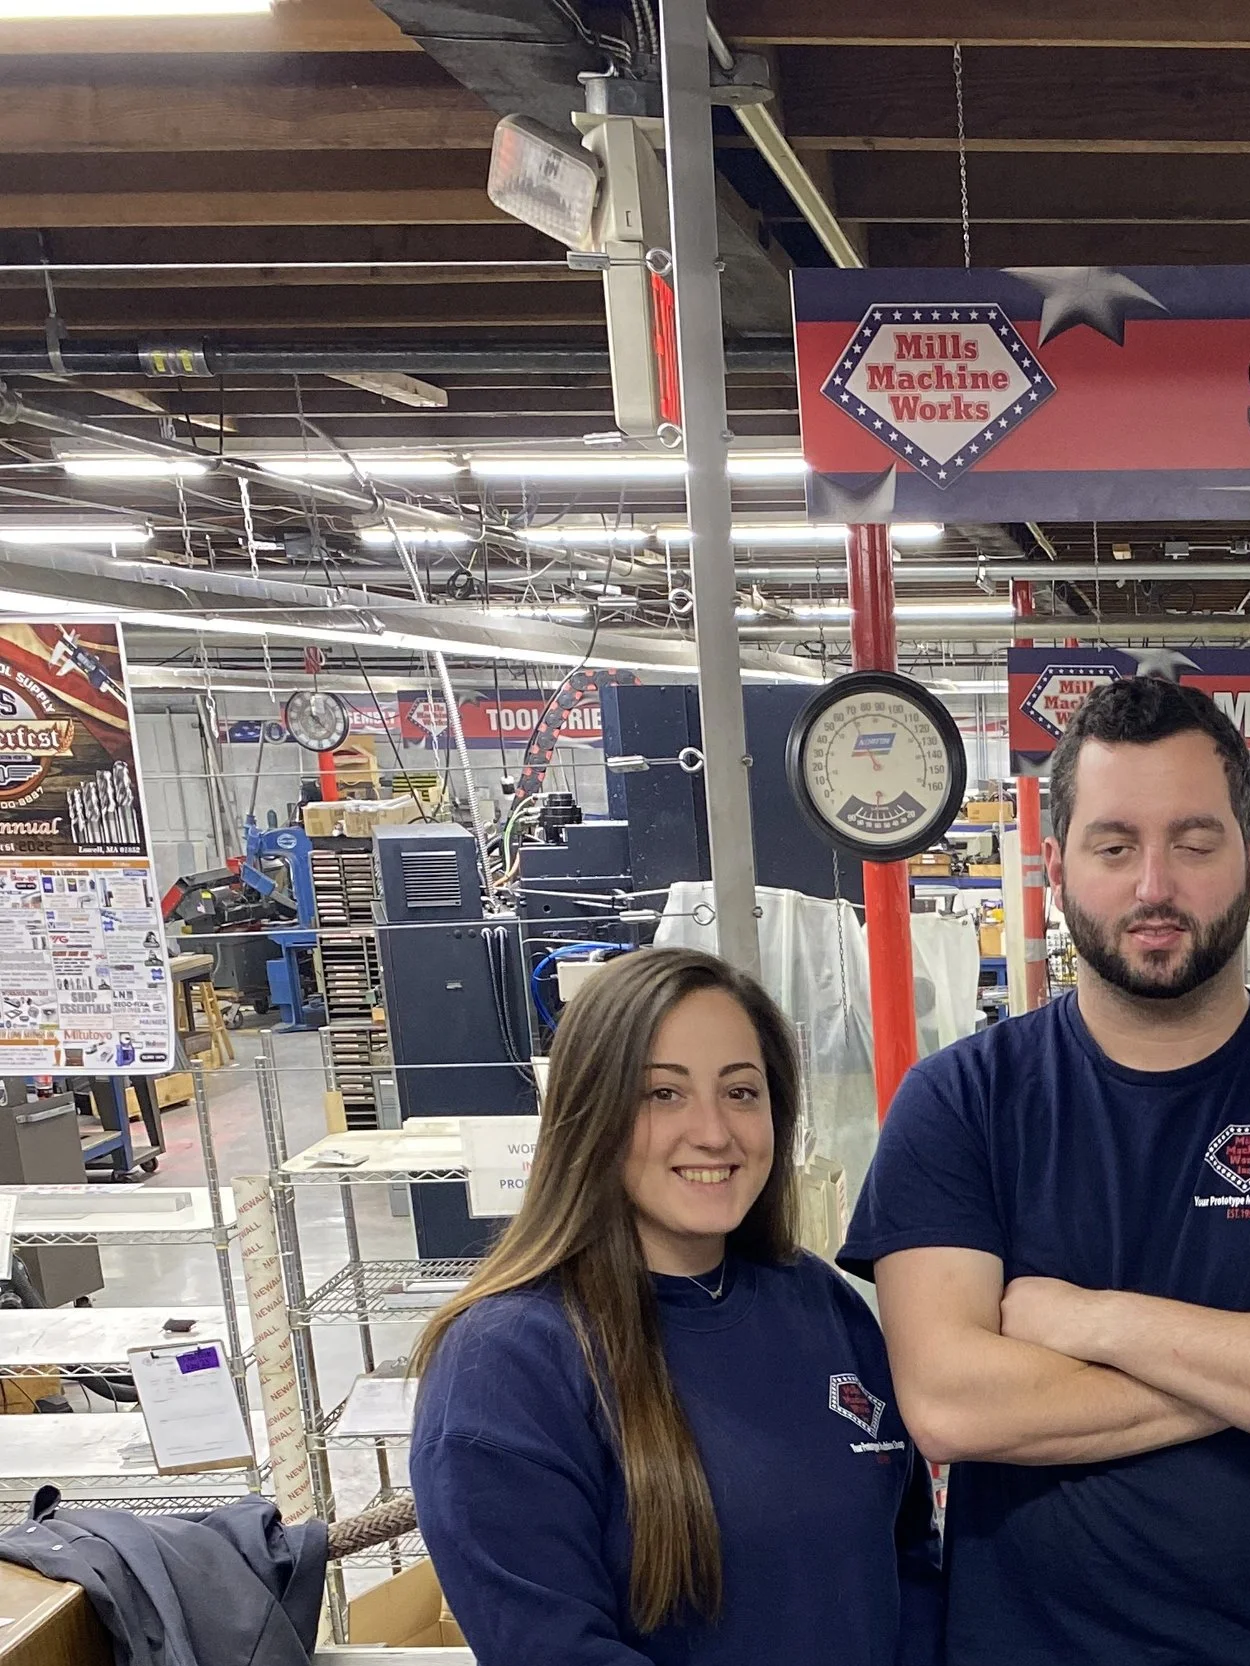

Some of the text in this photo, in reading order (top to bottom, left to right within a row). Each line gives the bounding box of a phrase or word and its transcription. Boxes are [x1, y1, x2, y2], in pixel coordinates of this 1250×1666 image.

[893, 333, 979, 360] Mills
[866, 364, 1009, 391] Machine
[889, 395, 990, 422] Works
[1059, 680, 1094, 694] Mill
[15, 672, 56, 713] SUPPLY
[846, 706, 857, 715] 70
[860, 702, 871, 711] 80
[875, 702, 886, 711] 90
[888, 705, 904, 714] 100
[833, 713, 844, 722] 60
[904, 713, 919, 722] 110
[824, 722, 835, 731] 50
[914, 724, 930, 733] 120
[817, 735, 828, 744] 40
[922, 736, 938, 746] 130
[813, 749, 823, 758] 30
[927, 750, 943, 759] 140
[812, 763, 823, 771] 20
[929, 765, 945, 775] 150
[815, 775, 825, 785] 10
[927, 782, 943, 791] 160
[20, 842, 53, 852] 2022
[64, 1030, 112, 1041] Mitutoyo
[500, 1179, 528, 1189] PRO
[238, 1190, 270, 1216] NEWALL
[1194, 1196, 1209, 1206] Your
[1210, 1195, 1244, 1207] Prototype
